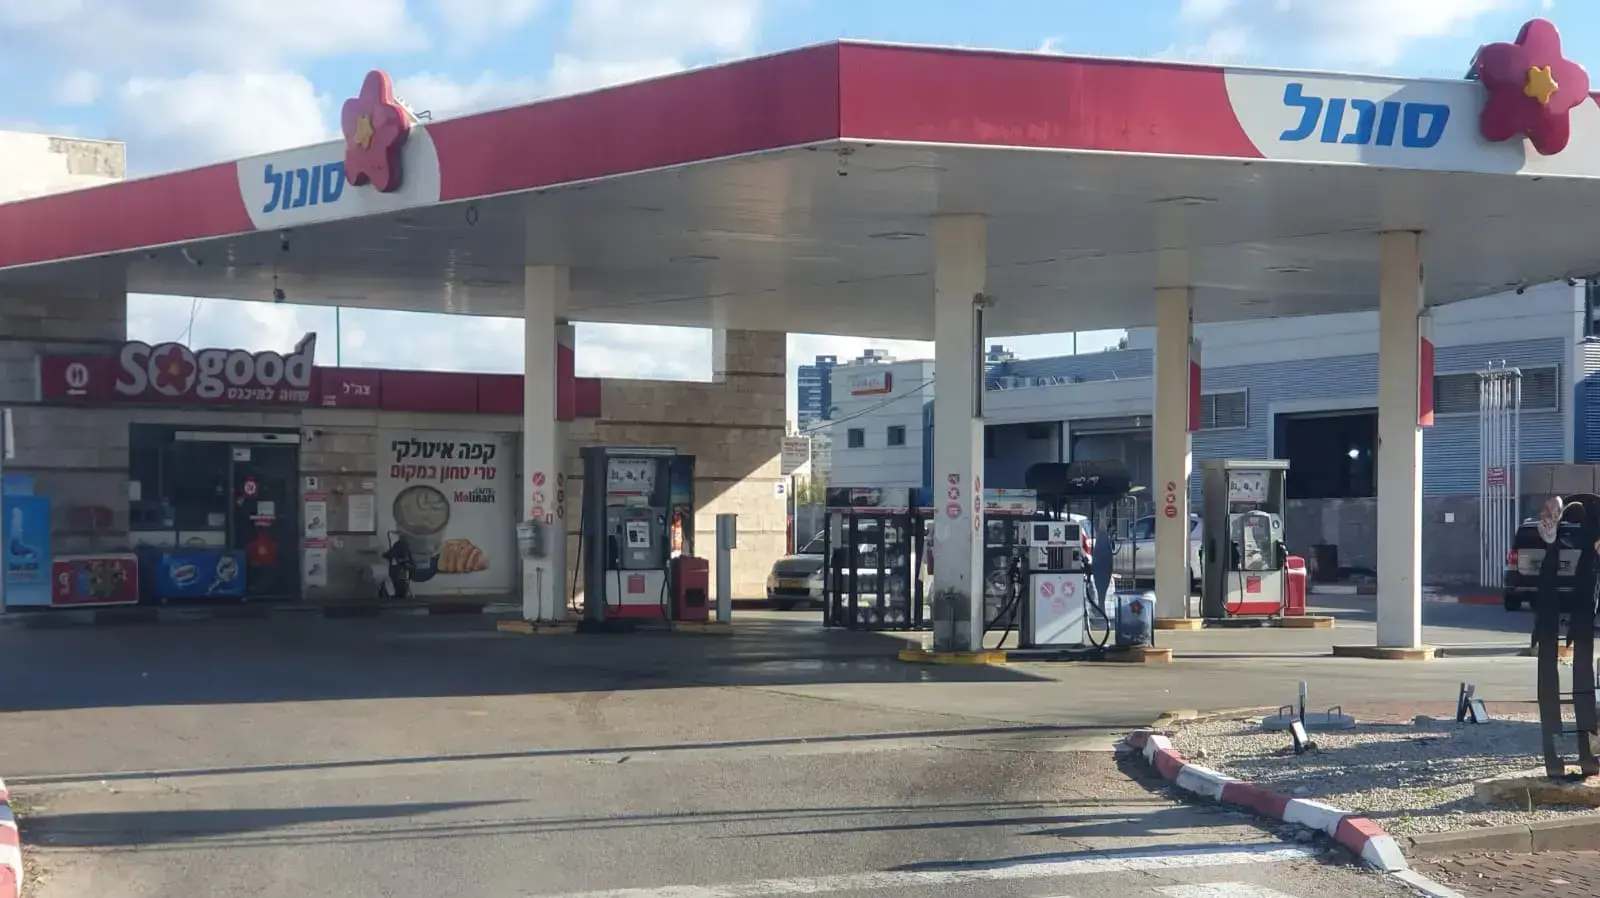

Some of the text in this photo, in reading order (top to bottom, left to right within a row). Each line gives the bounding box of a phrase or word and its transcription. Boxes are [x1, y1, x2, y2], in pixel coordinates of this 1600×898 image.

[1278, 82, 1451, 148] סונול
[262, 160, 346, 214] סונול
[391, 437, 496, 465] קפה איטלקי
[389, 464, 497, 483] טרי טחון במקום
